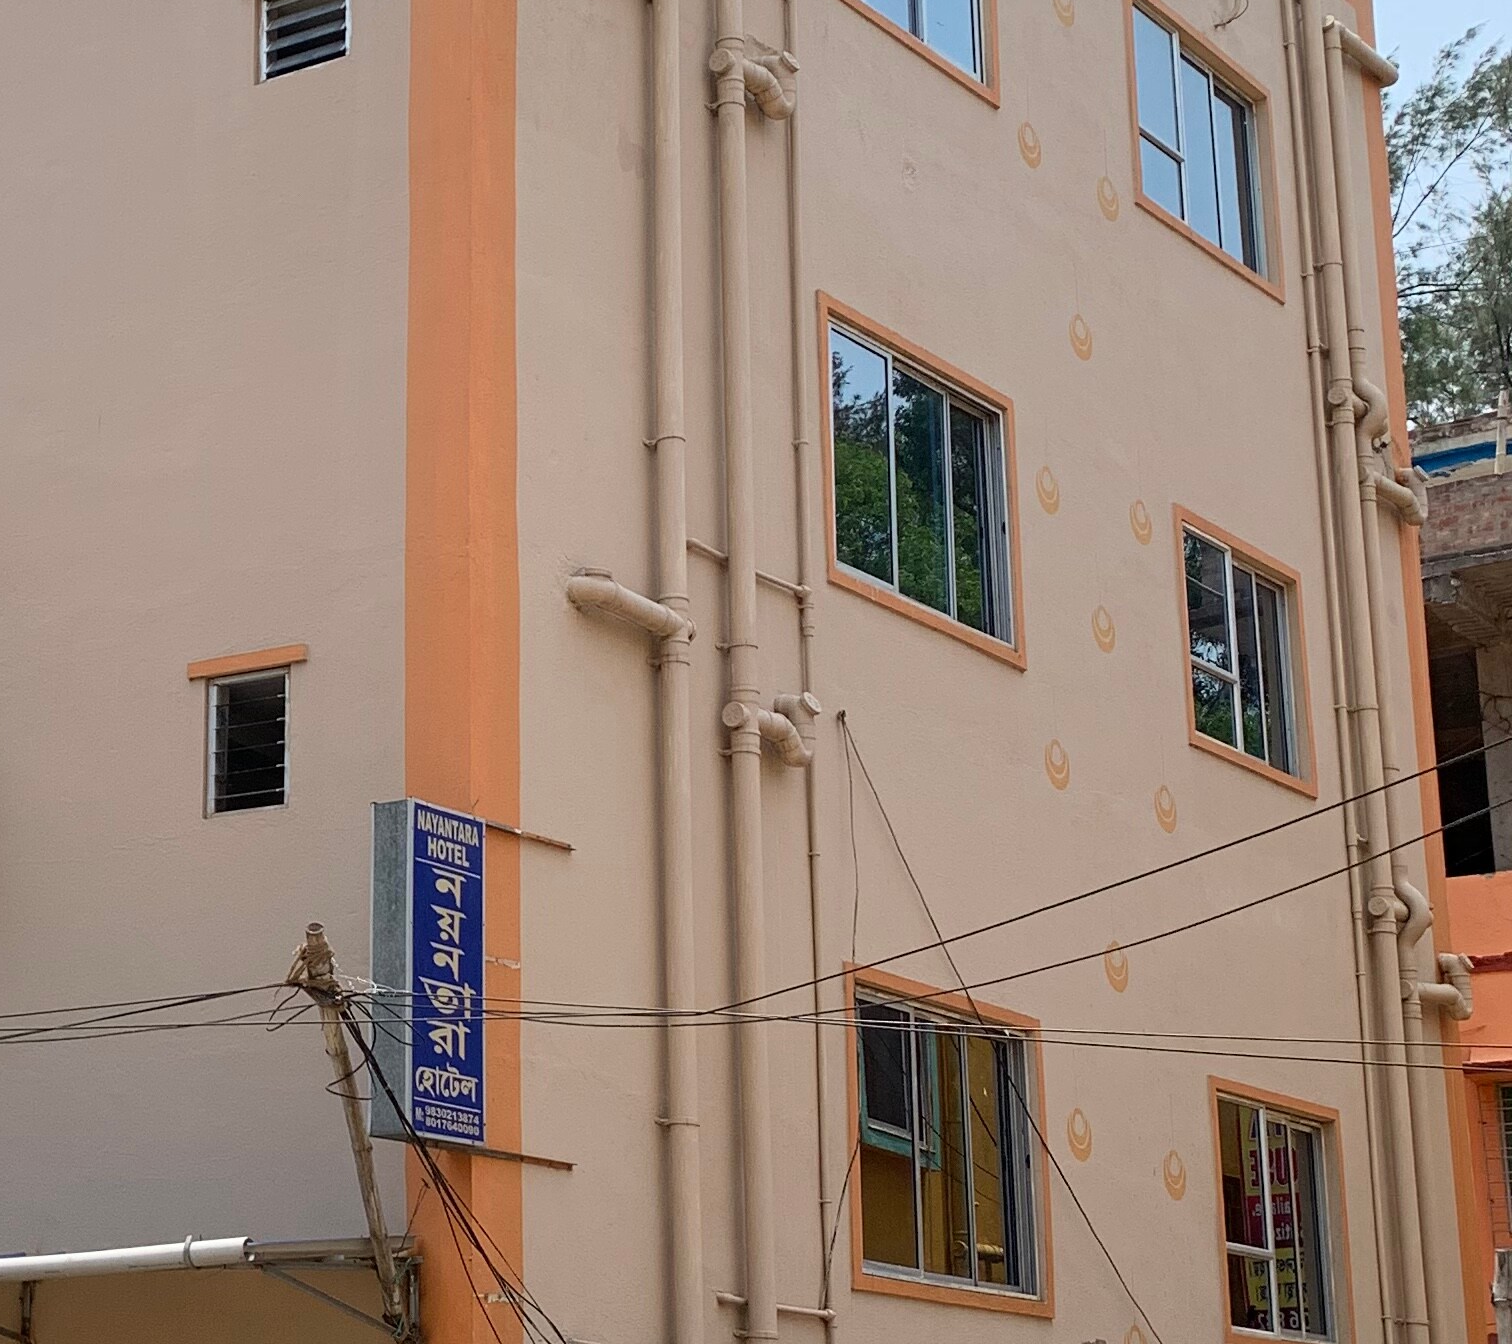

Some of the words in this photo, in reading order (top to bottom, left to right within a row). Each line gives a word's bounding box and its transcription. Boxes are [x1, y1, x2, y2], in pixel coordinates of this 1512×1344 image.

[417, 809, 479, 847] NAYANTARA
[427, 835, 470, 868] HOTEL
[415, 1062, 479, 1103] হোটেল
